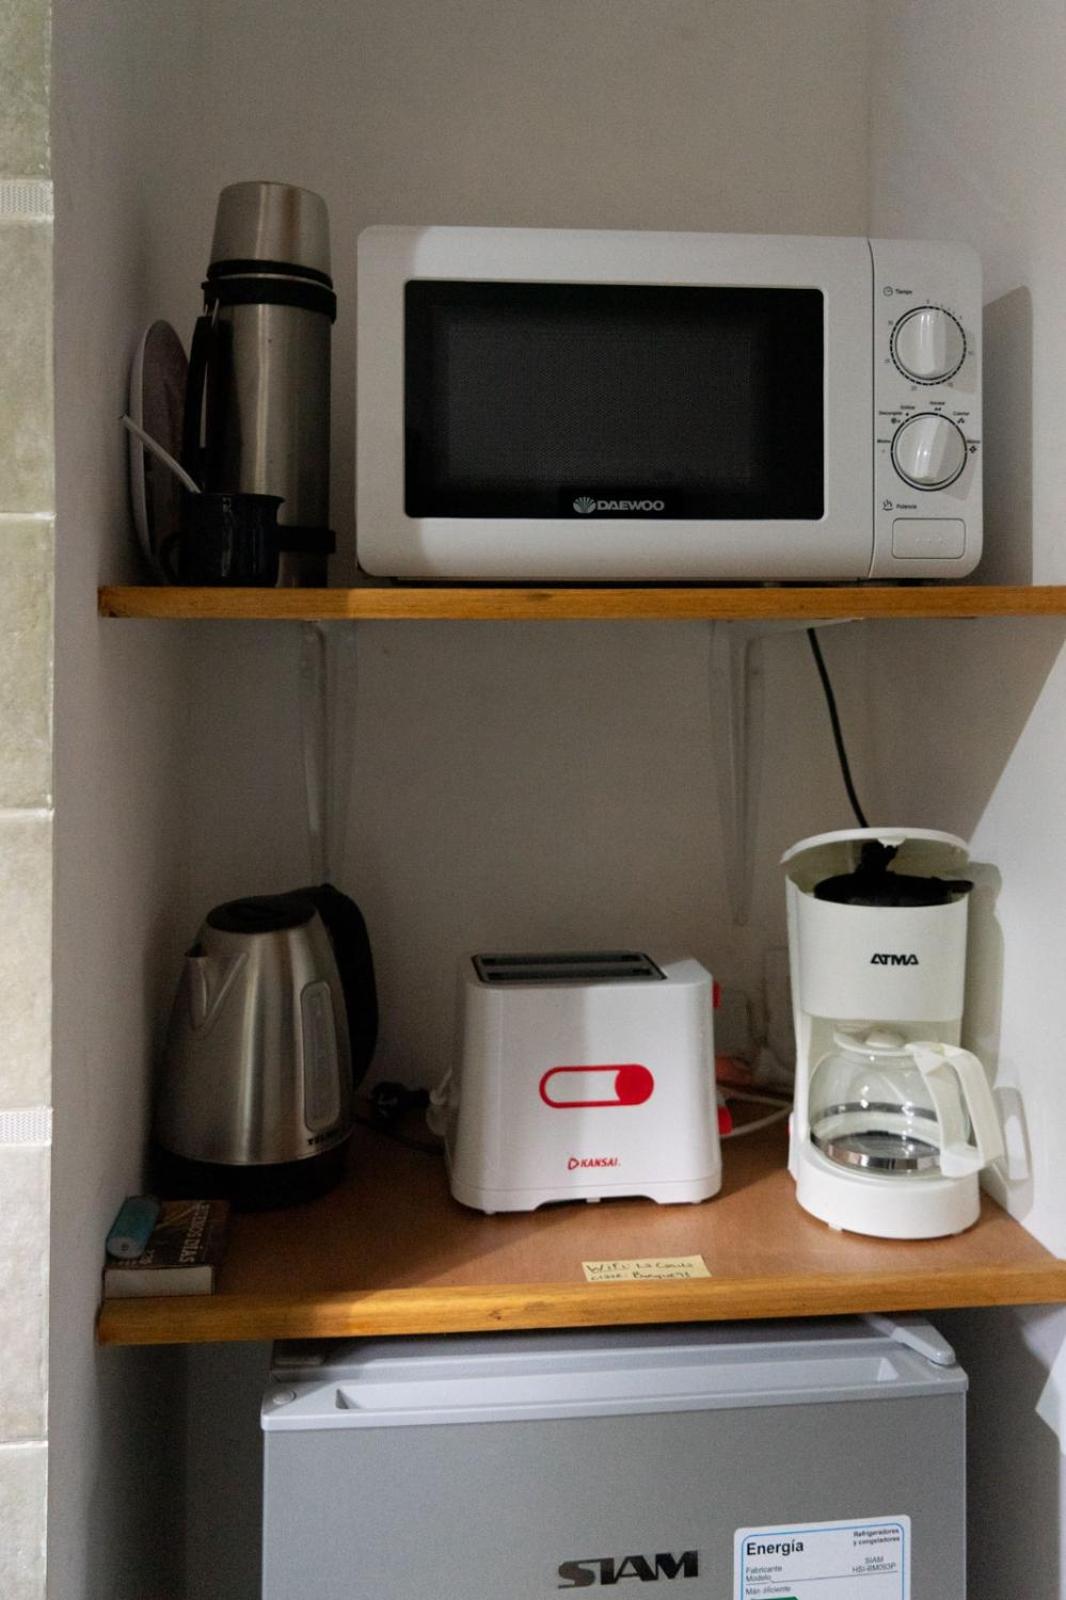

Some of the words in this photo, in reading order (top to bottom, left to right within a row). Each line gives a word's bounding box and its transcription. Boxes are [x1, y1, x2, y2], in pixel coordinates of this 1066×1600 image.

[597, 500, 665, 511] DAEWOO
[870, 953, 919, 966] ATMA
[579, 1157, 618, 1168] KANSAI
[746, 1539, 804, 1556] Energía
[558, 1550, 699, 1590] SIAM
